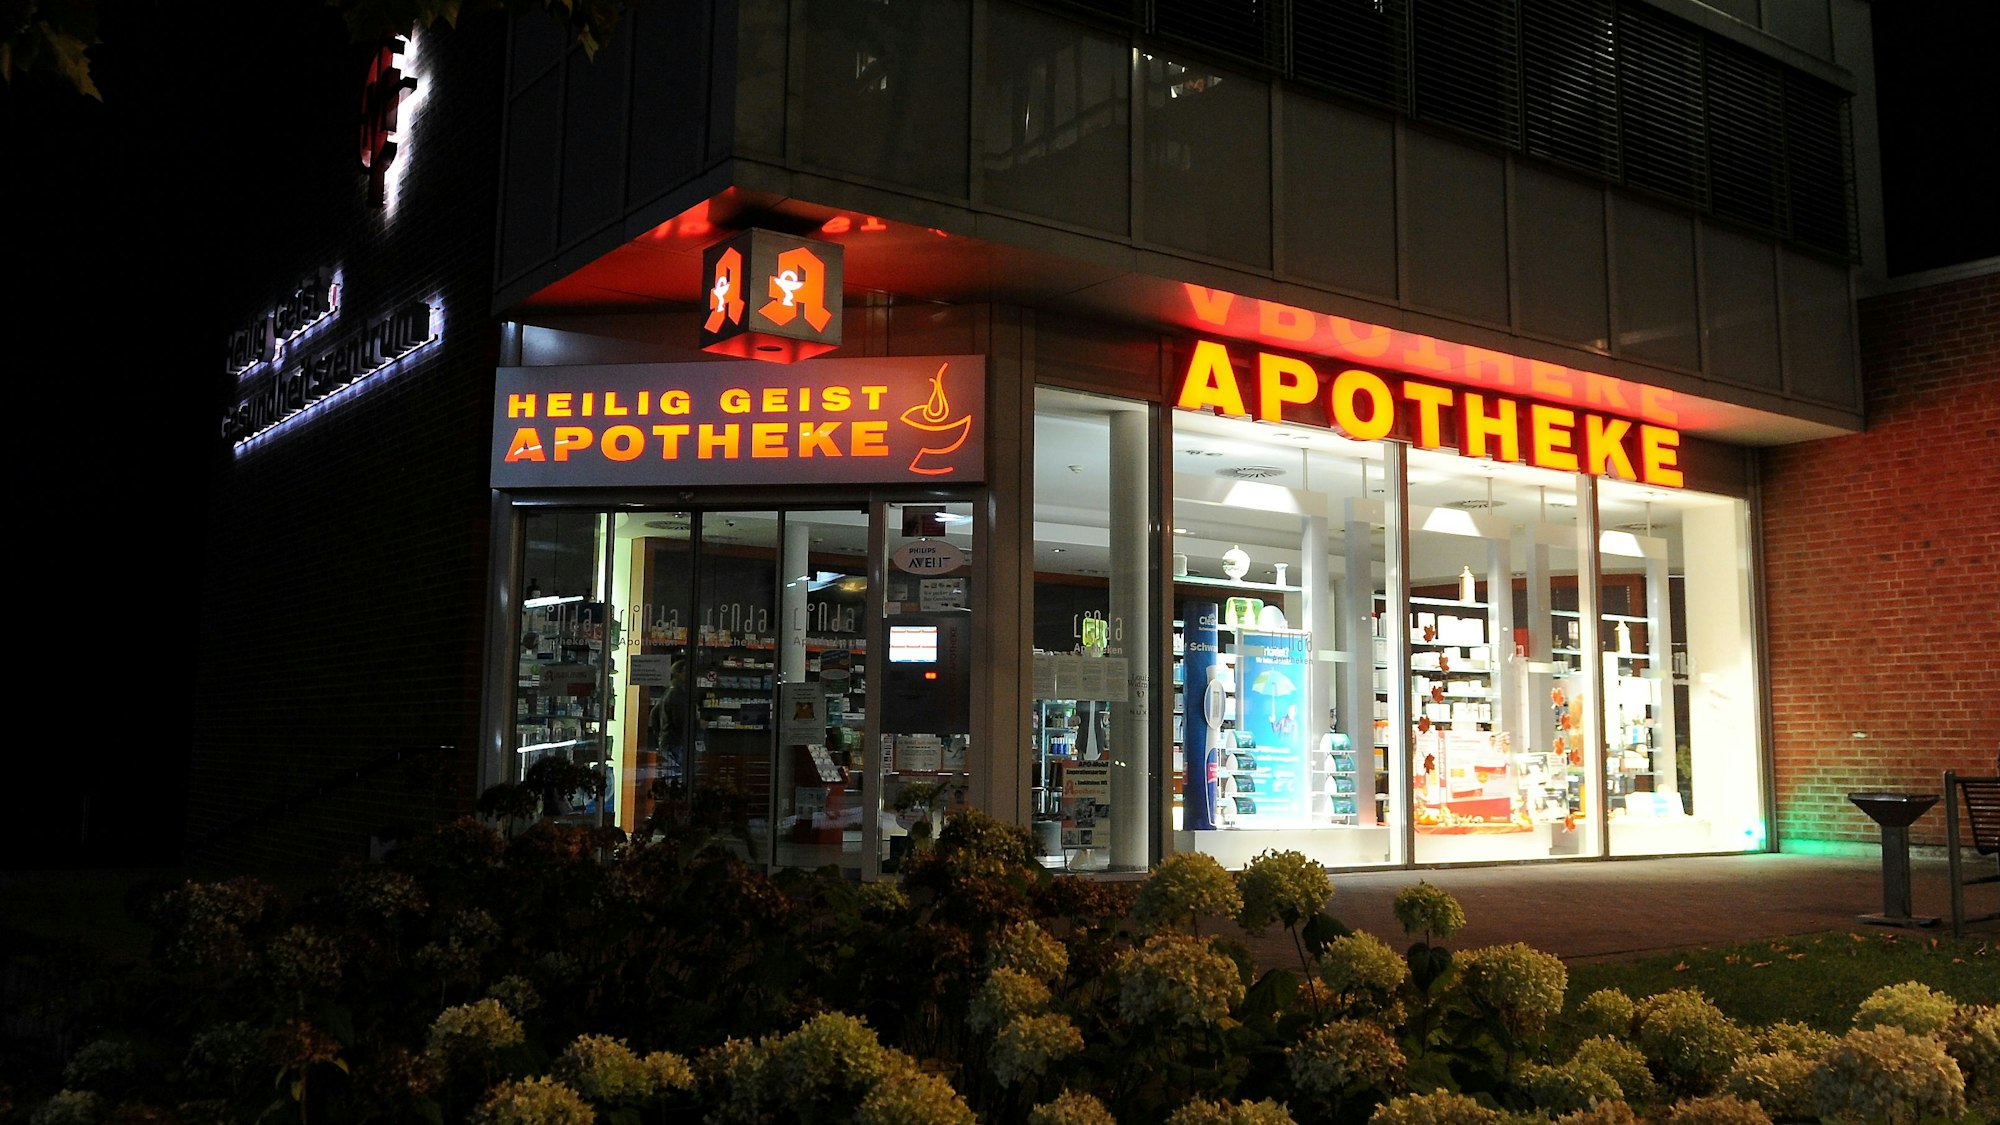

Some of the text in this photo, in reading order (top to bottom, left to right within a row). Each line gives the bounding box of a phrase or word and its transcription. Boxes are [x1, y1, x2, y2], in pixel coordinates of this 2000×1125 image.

[507, 385, 890, 418] HEILIG GEIST
[1177, 339, 1685, 488] APOTHEKE
[504, 420, 890, 462] APOTHEKE
